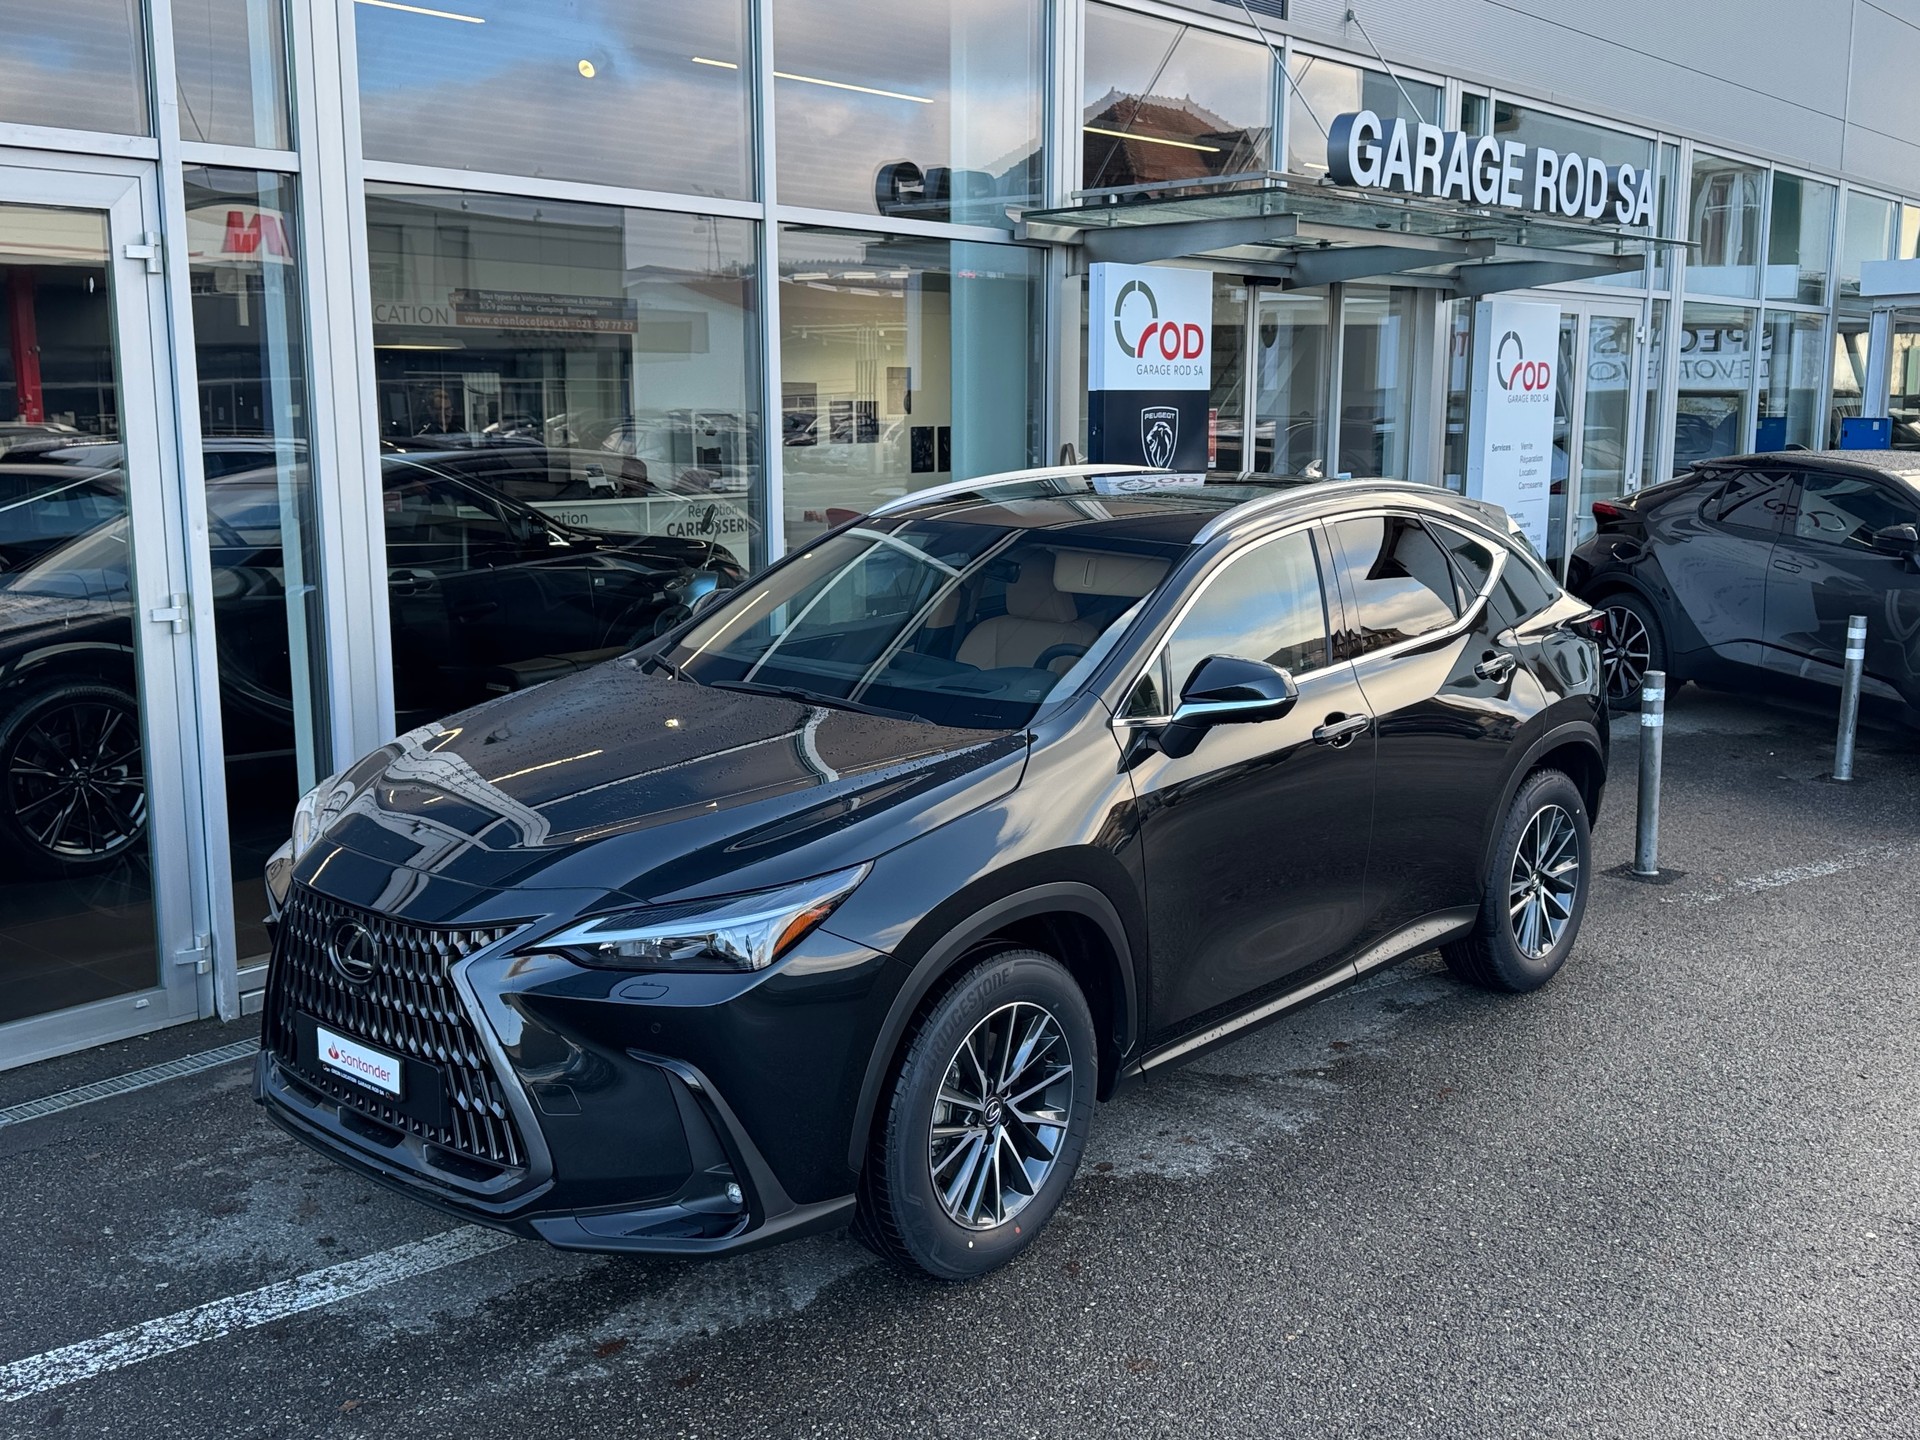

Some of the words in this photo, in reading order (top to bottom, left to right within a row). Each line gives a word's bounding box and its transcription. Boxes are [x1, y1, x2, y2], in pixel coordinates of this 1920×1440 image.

[1349, 110, 1526, 207] GARAGE
[1534, 147, 1608, 219] ROD
[1616, 163, 1654, 226] SA
[521, 304, 532, 312] Bus
[536, 305, 564, 315] Camping
[464, 315, 568, 328] www.oronlocation.ch
[595, 321, 609, 329] 907
[612, 321, 621, 329] 77
[1136, 364, 1172, 376] GARAGE
[1174, 364, 1192, 376] ROD
[1194, 364, 1204, 376] SA
[1507, 393, 1529, 403] GARAGE
[1530, 393, 1542, 402] ROD
[1542, 393, 1549, 402] SA
[1144, 411, 1176, 420] PEUGEOT
[1491, 443, 1511, 453] Services
[1520, 442, 1533, 450] Vente
[1519, 454, 1544, 465] Réparation
[1518, 467, 1537, 477] Location
[1518, 481, 1543, 490] Carrosserie
[923, 967, 1010, 1075] BRIDGESTONE
[340, 1049, 391, 1083] Santander
